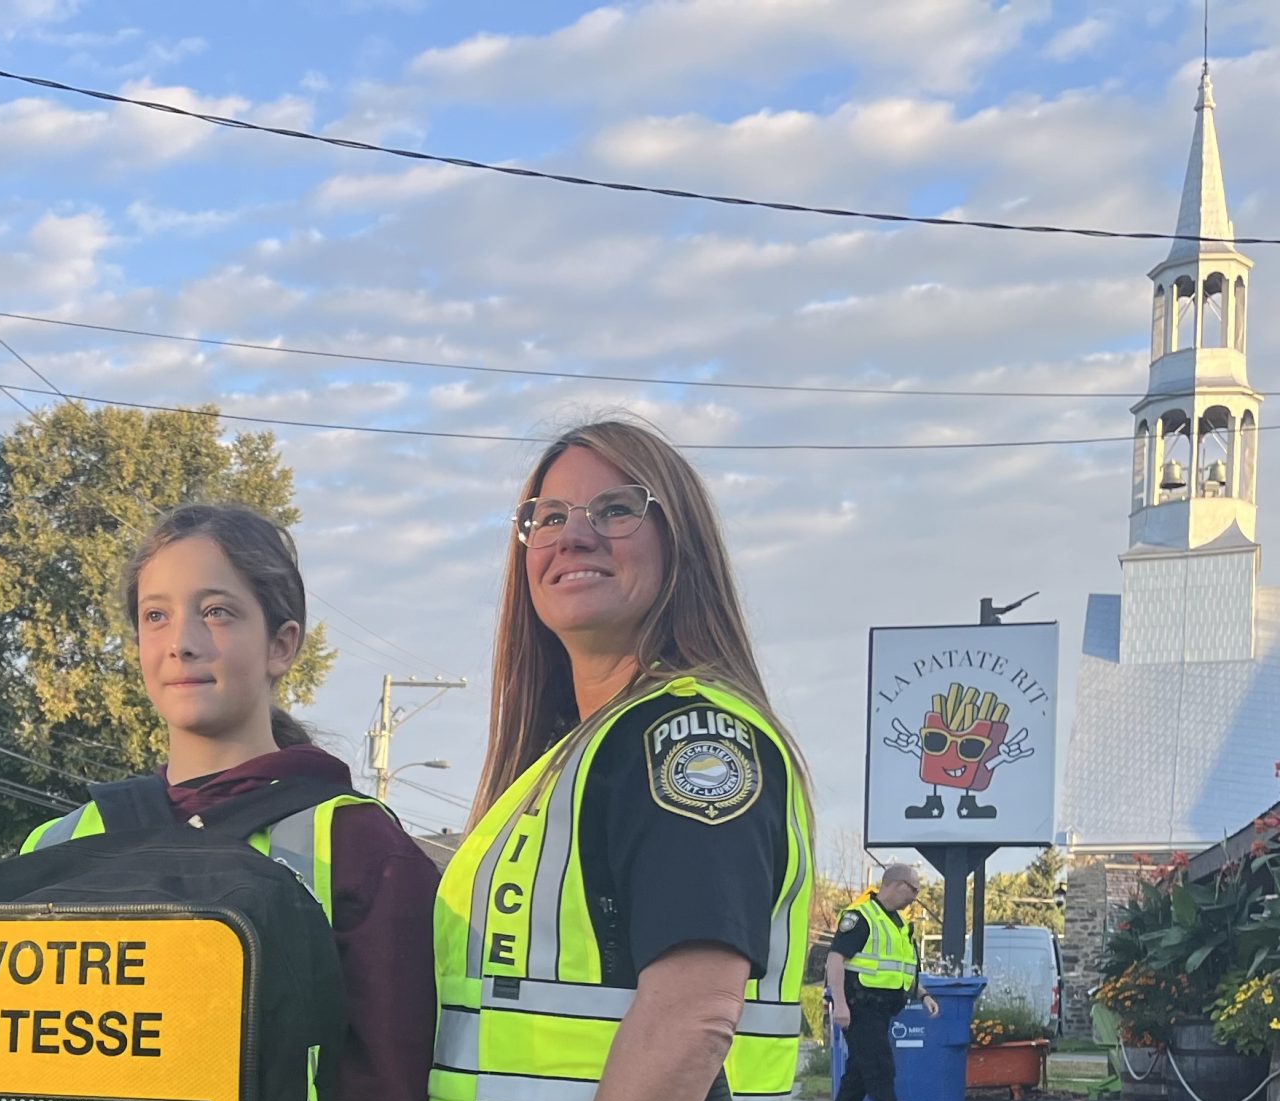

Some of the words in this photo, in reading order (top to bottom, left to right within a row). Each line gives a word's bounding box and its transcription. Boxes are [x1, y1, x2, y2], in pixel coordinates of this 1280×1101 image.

[878, 675, 911, 703] LA
[914, 649, 1009, 677] PATATE
[1010, 667, 1049, 704] RIT
[653, 711, 751, 754] POLICE
[679, 746, 732, 764] RICHELIEU
[674, 770, 739, 796] SAINT-LAURENT
